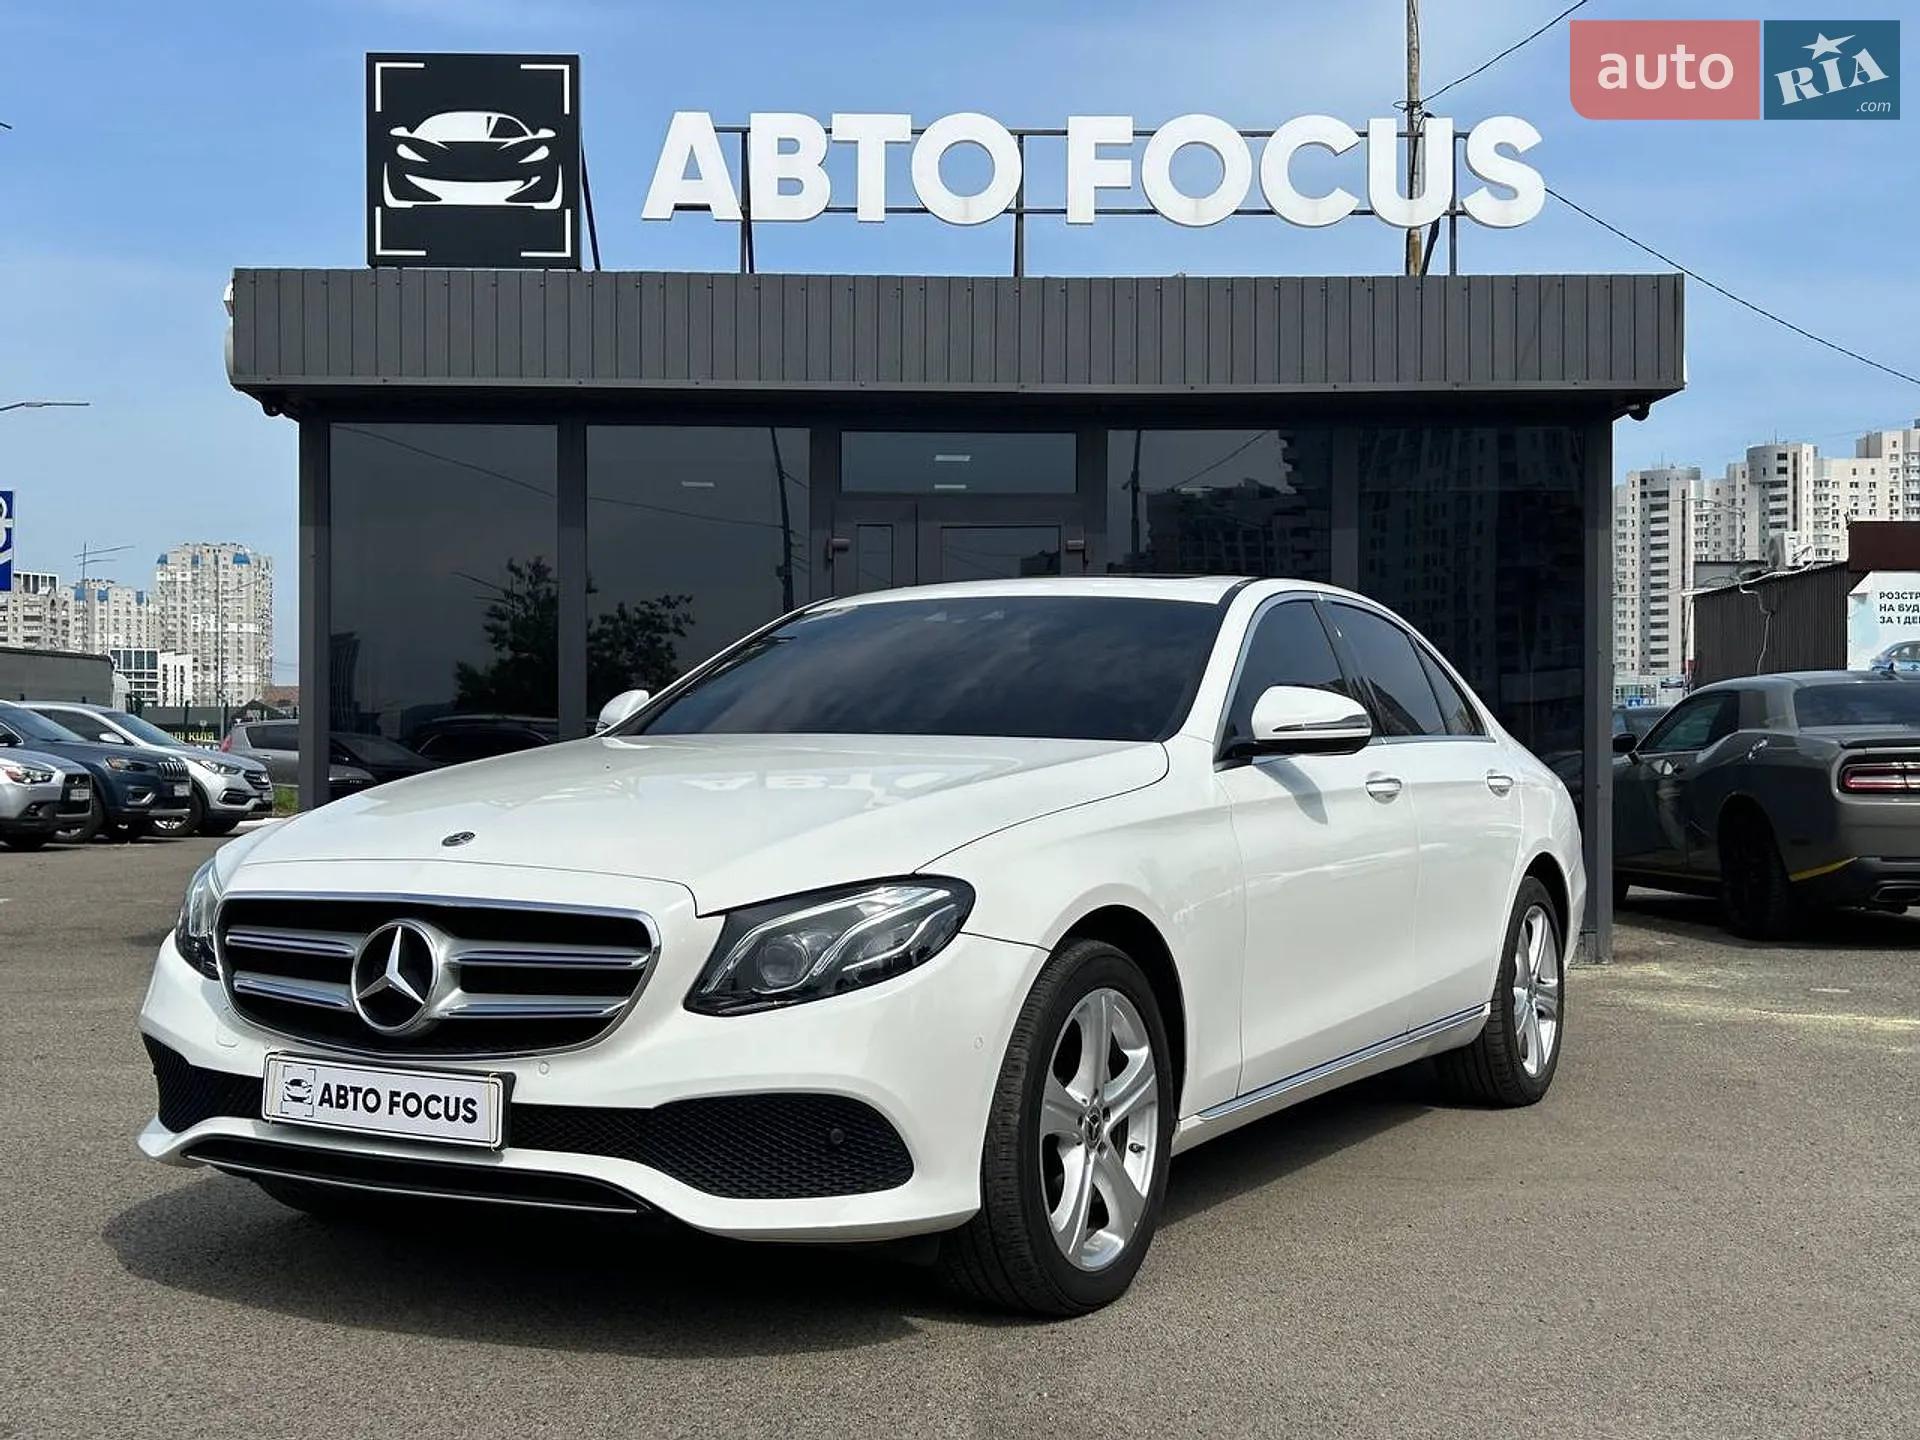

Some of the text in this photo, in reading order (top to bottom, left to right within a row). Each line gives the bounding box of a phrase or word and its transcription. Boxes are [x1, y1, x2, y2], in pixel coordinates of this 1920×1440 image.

[641, 111, 1546, 228] АВТО FOCUS
[1879, 603, 1895, 612] НА
[1879, 615, 1894, 624] ЗА
[1903, 615, 1920, 625] ДЕ
[318, 1082, 479, 1124] АВТО FOCUS
